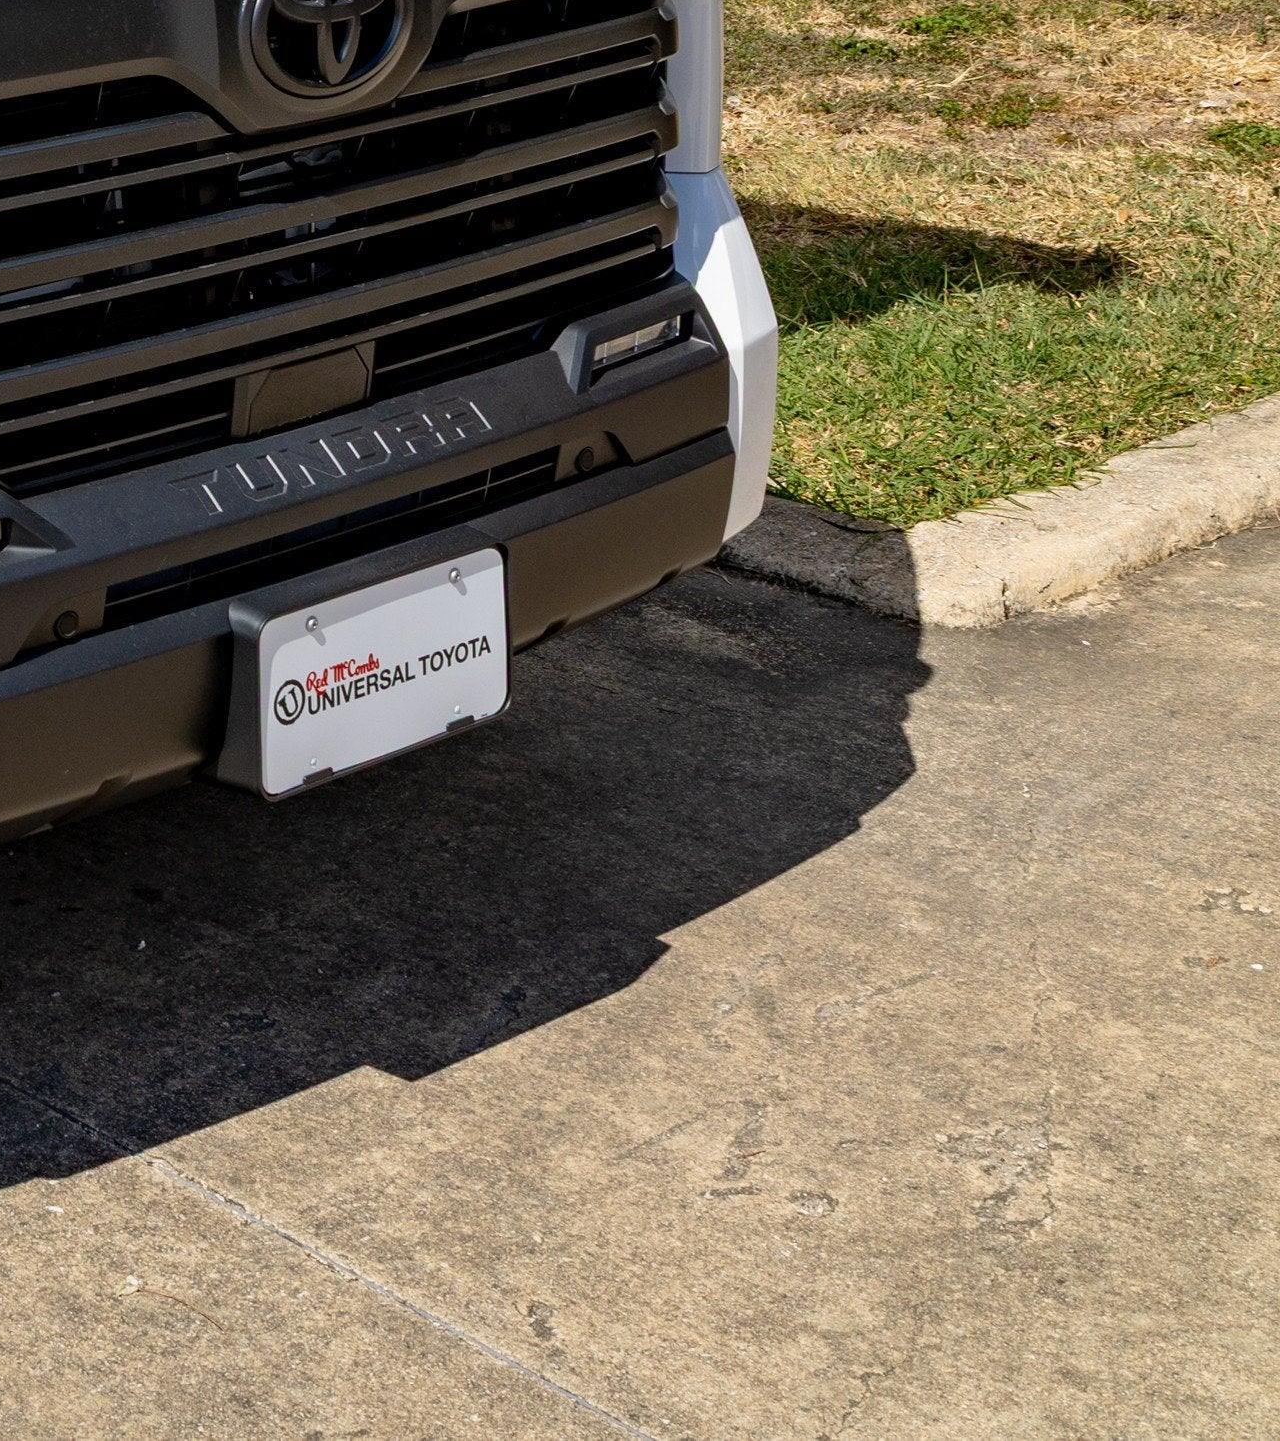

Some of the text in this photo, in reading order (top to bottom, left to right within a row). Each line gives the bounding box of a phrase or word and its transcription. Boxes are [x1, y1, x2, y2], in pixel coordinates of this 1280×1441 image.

[167, 397, 493, 516] TUNDRA
[306, 667, 329, 696] Red
[330, 652, 380, 684] McCombs
[307, 635, 492, 715] UNIVERSAL TOYOTA
